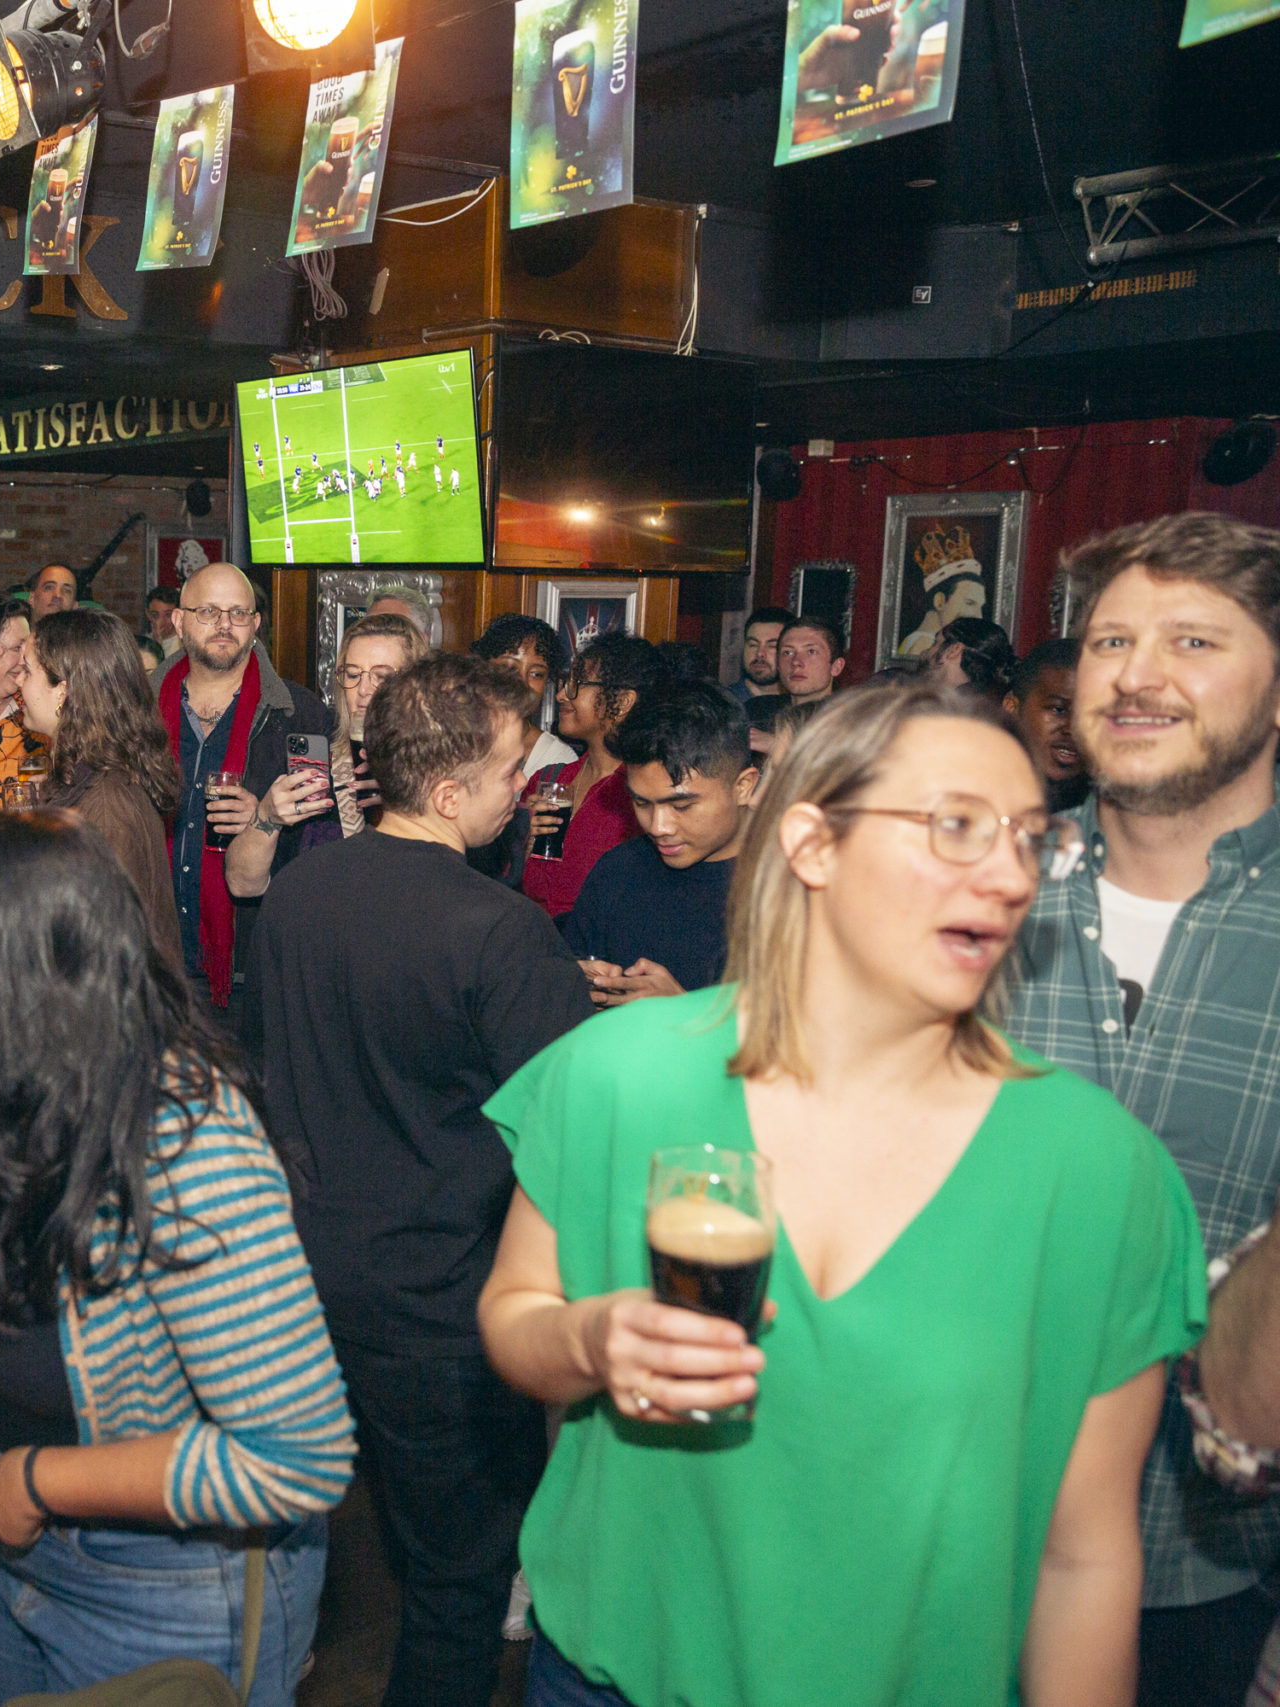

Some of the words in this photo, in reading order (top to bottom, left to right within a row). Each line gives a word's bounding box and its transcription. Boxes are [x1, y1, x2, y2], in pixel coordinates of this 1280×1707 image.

[610, 0, 628, 94] GUINNES
[316, 87, 345, 106] TIMES
[210, 100, 228, 184] GUINNESS
